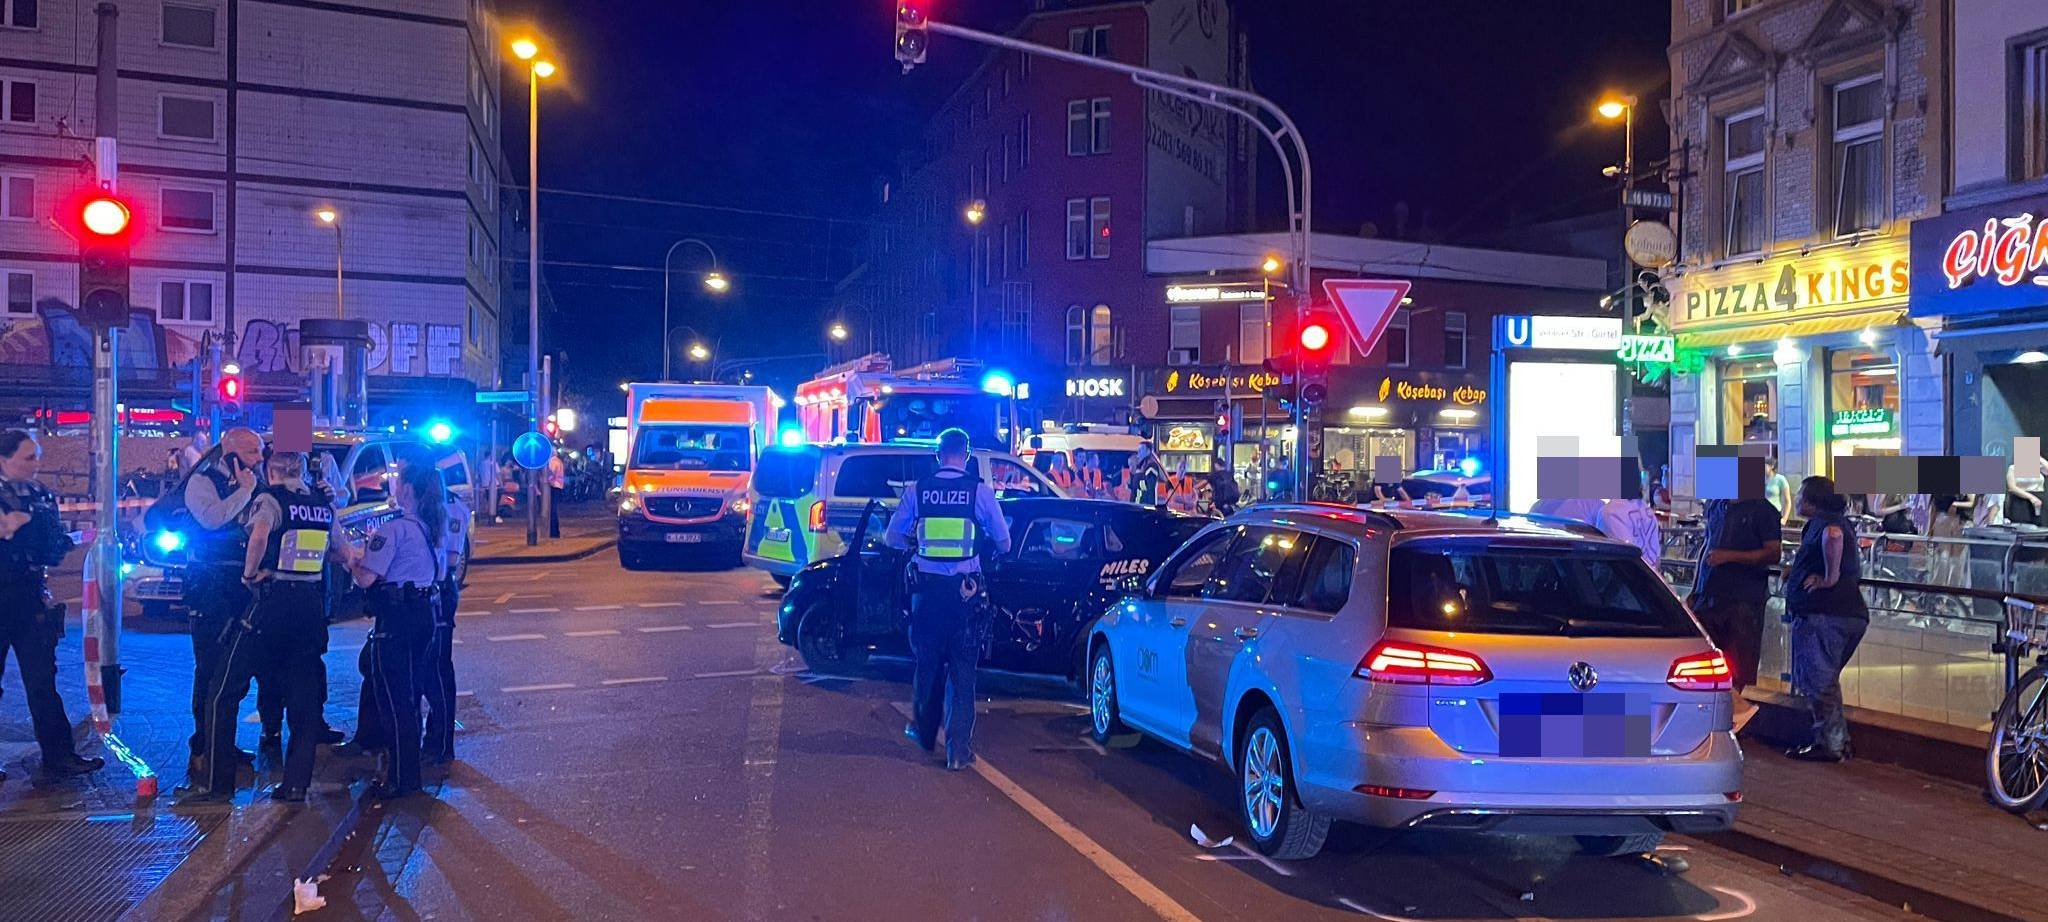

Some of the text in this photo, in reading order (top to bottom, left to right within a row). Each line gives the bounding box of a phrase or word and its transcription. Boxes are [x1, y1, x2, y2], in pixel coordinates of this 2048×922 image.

[1687, 259, 1908, 320] PIZZA 4 KINGS
[1507, 318, 1528, 345] U
[1066, 378, 1124, 397] KIOSK
[1453, 385, 1487, 405] Kebap
[922, 489, 970, 505] POLIZEI
[1100, 559, 1149, 577] MILES
